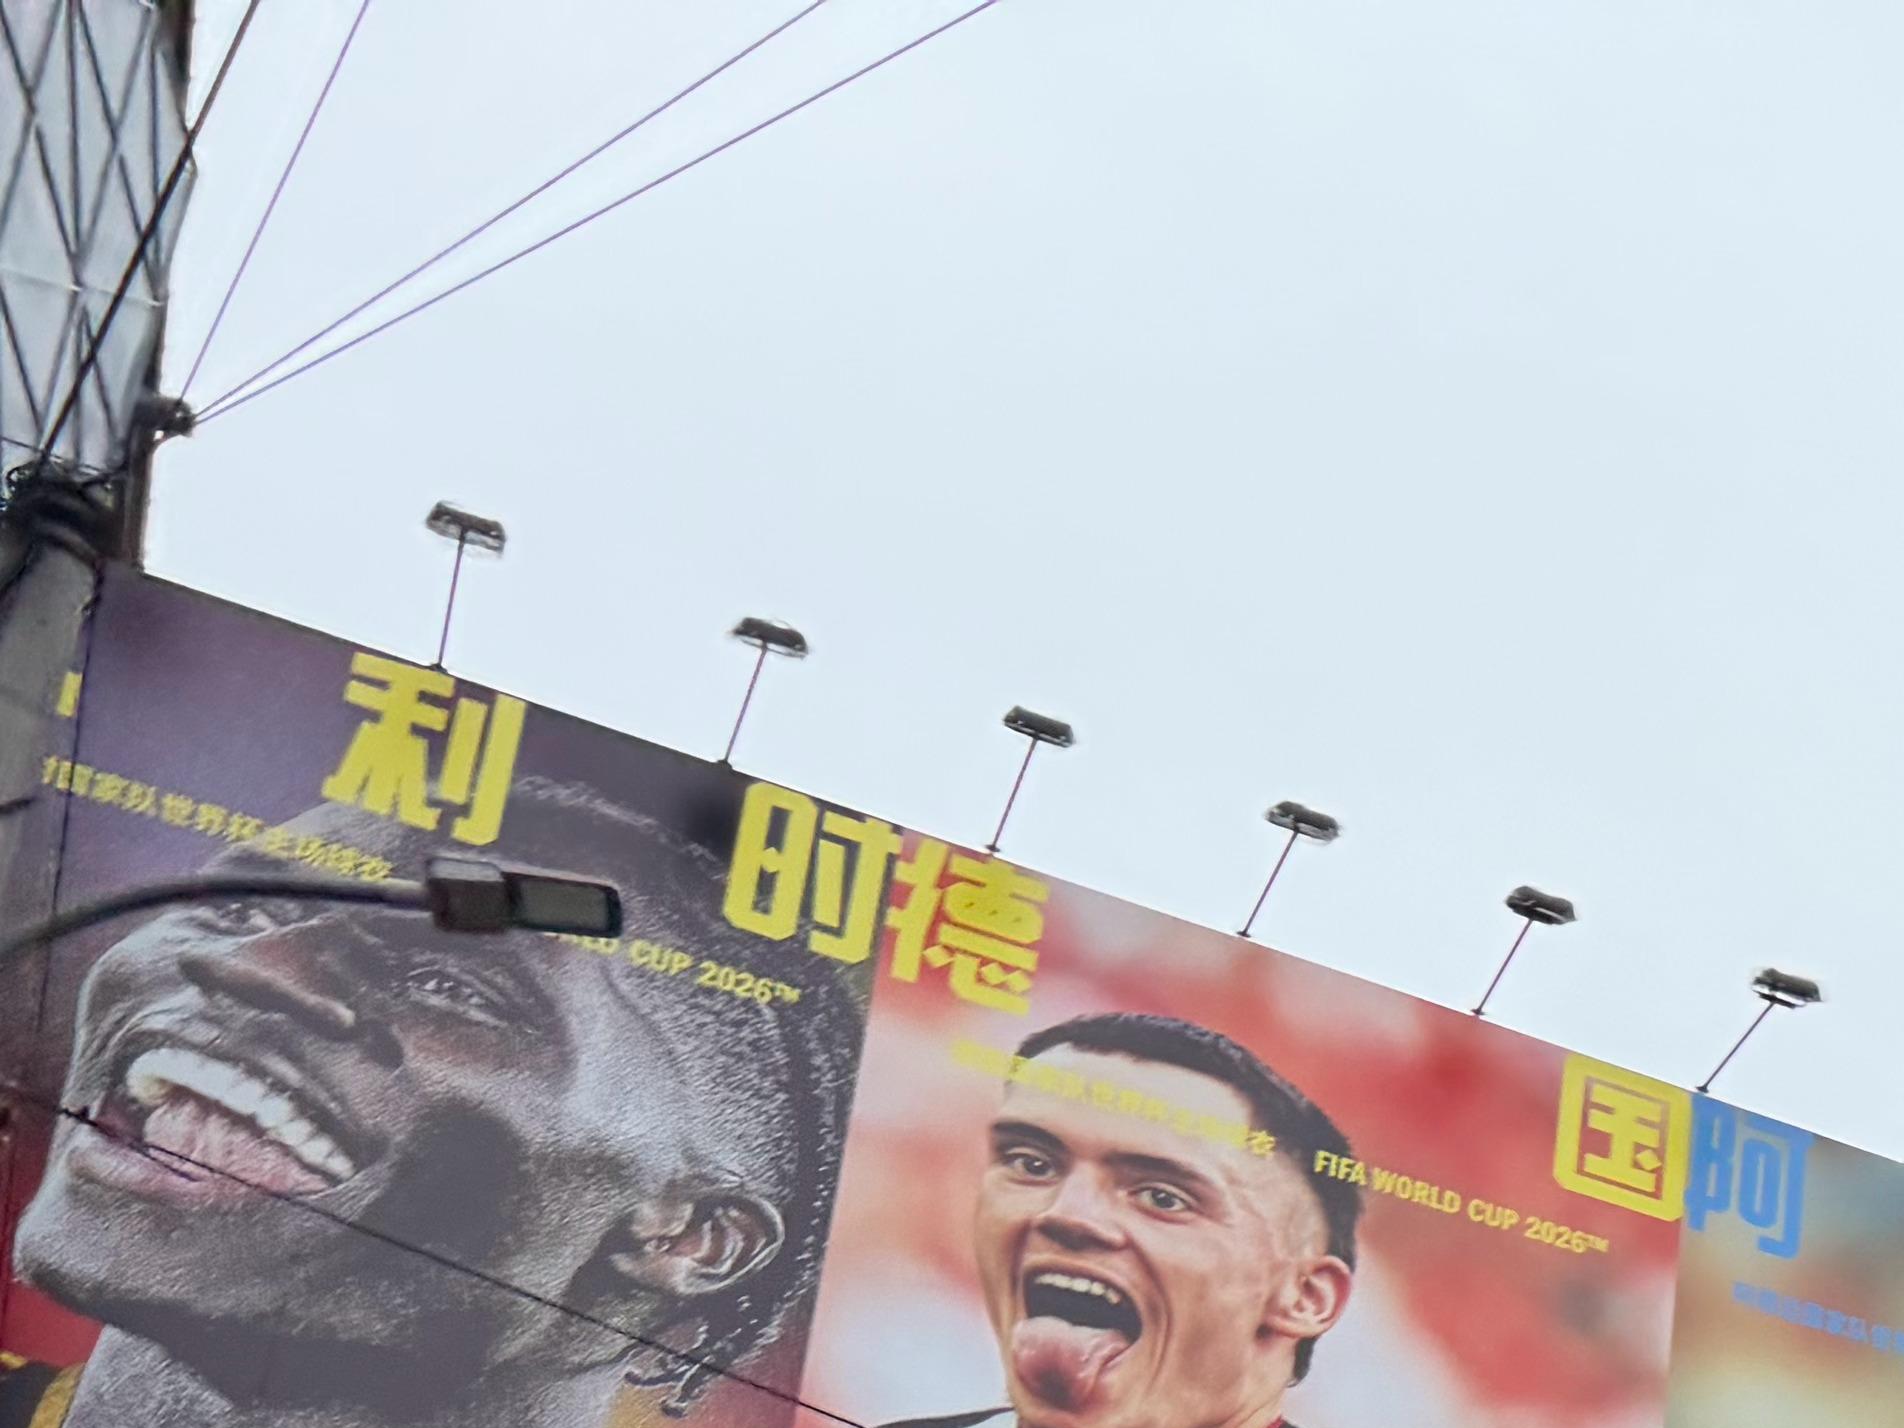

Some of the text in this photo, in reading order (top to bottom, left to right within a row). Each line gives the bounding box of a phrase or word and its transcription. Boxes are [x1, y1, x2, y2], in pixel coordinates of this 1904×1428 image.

[628, 938, 695, 976] CUP
[1313, 1150, 1367, 1187] FIFA
[1370, 1166, 1462, 1214] WORLD
[1467, 1198, 1521, 1231] CUP
